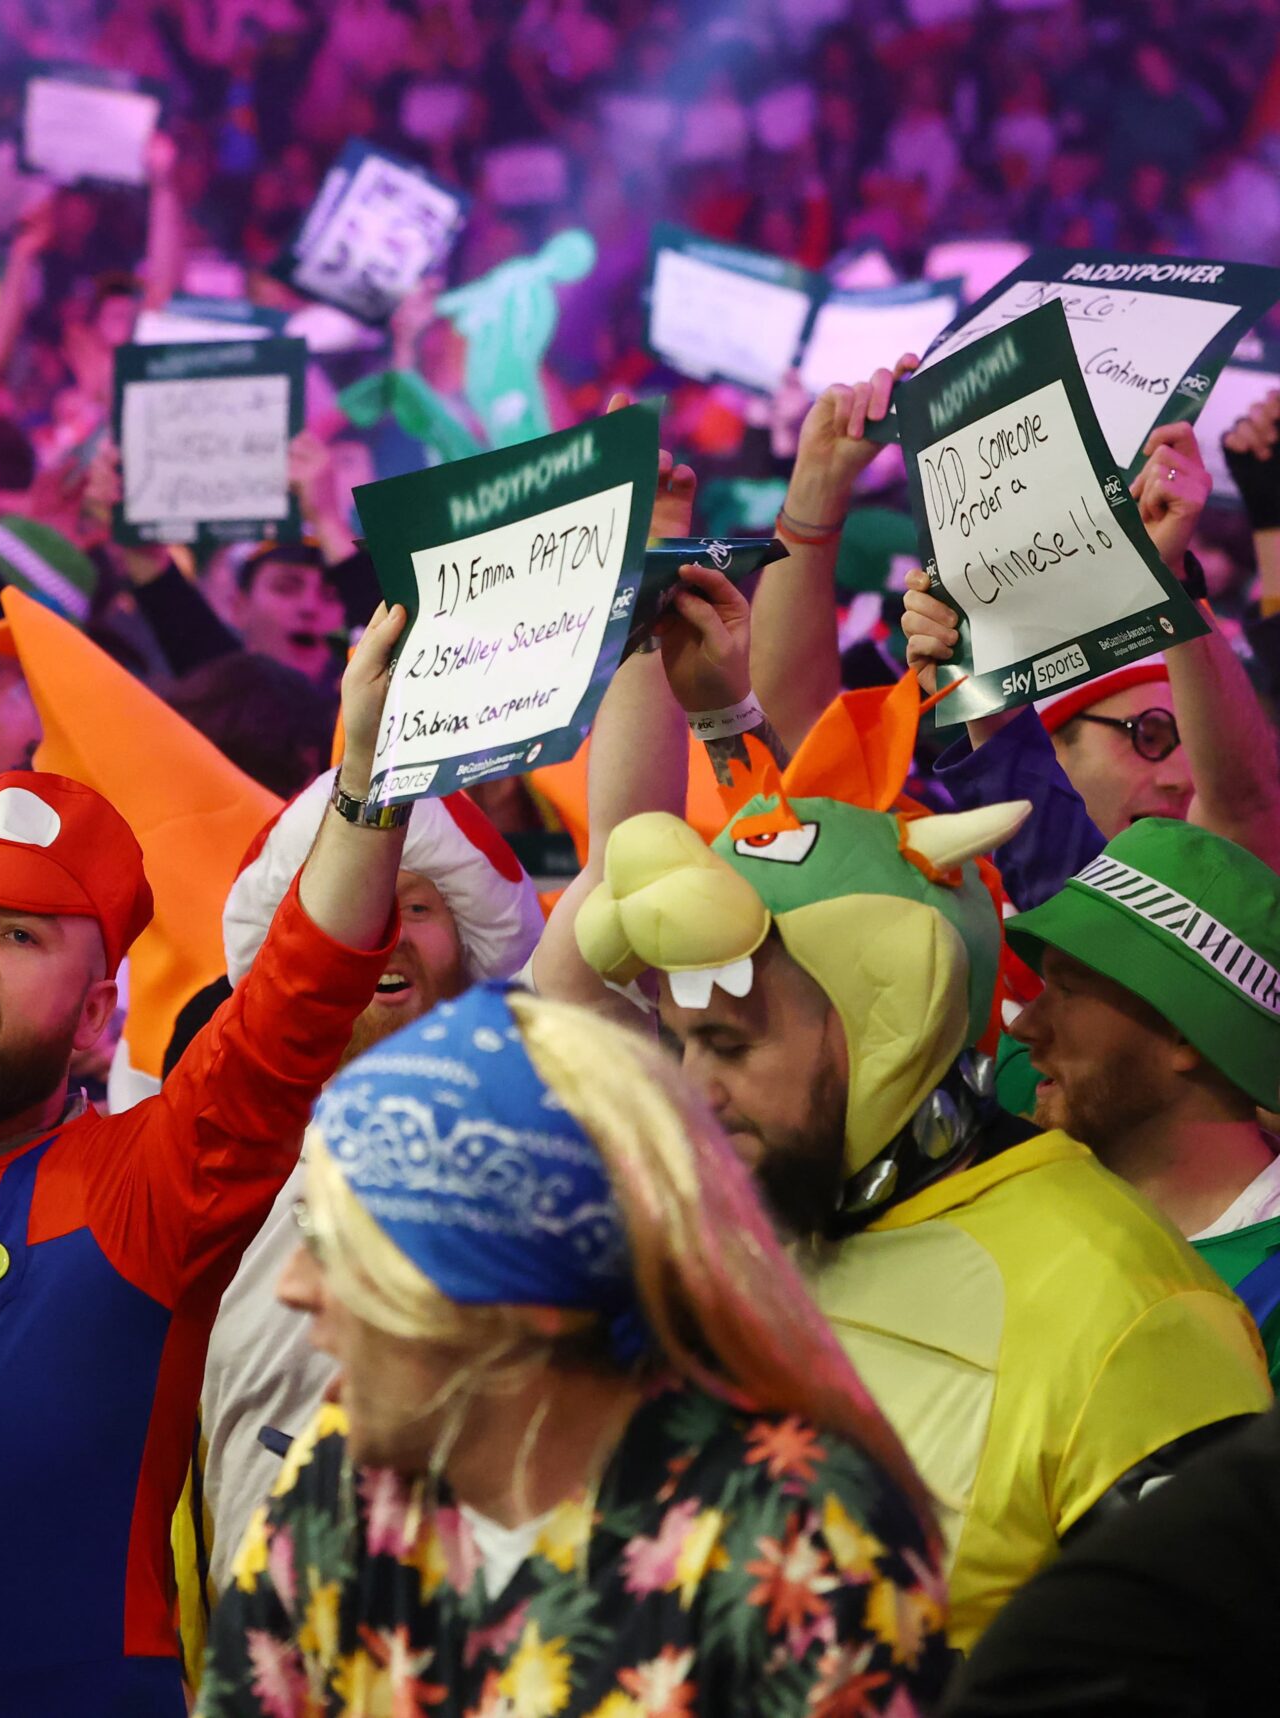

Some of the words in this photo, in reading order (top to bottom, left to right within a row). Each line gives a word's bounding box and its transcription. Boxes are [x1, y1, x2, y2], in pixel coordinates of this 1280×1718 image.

[1063, 262, 1225, 285] PADDYPOWER
[1084, 347, 1170, 396] Continues
[449, 432, 598, 531] PADDYPOWER
[959, 482, 1002, 537] order
[1011, 477, 1027, 495] a
[466, 556, 515, 603] Emma
[528, 508, 616, 587] PATON
[507, 605, 595, 658] Sweeney
[1002, 664, 1036, 697] sky
[1037, 651, 1086, 685] sports
